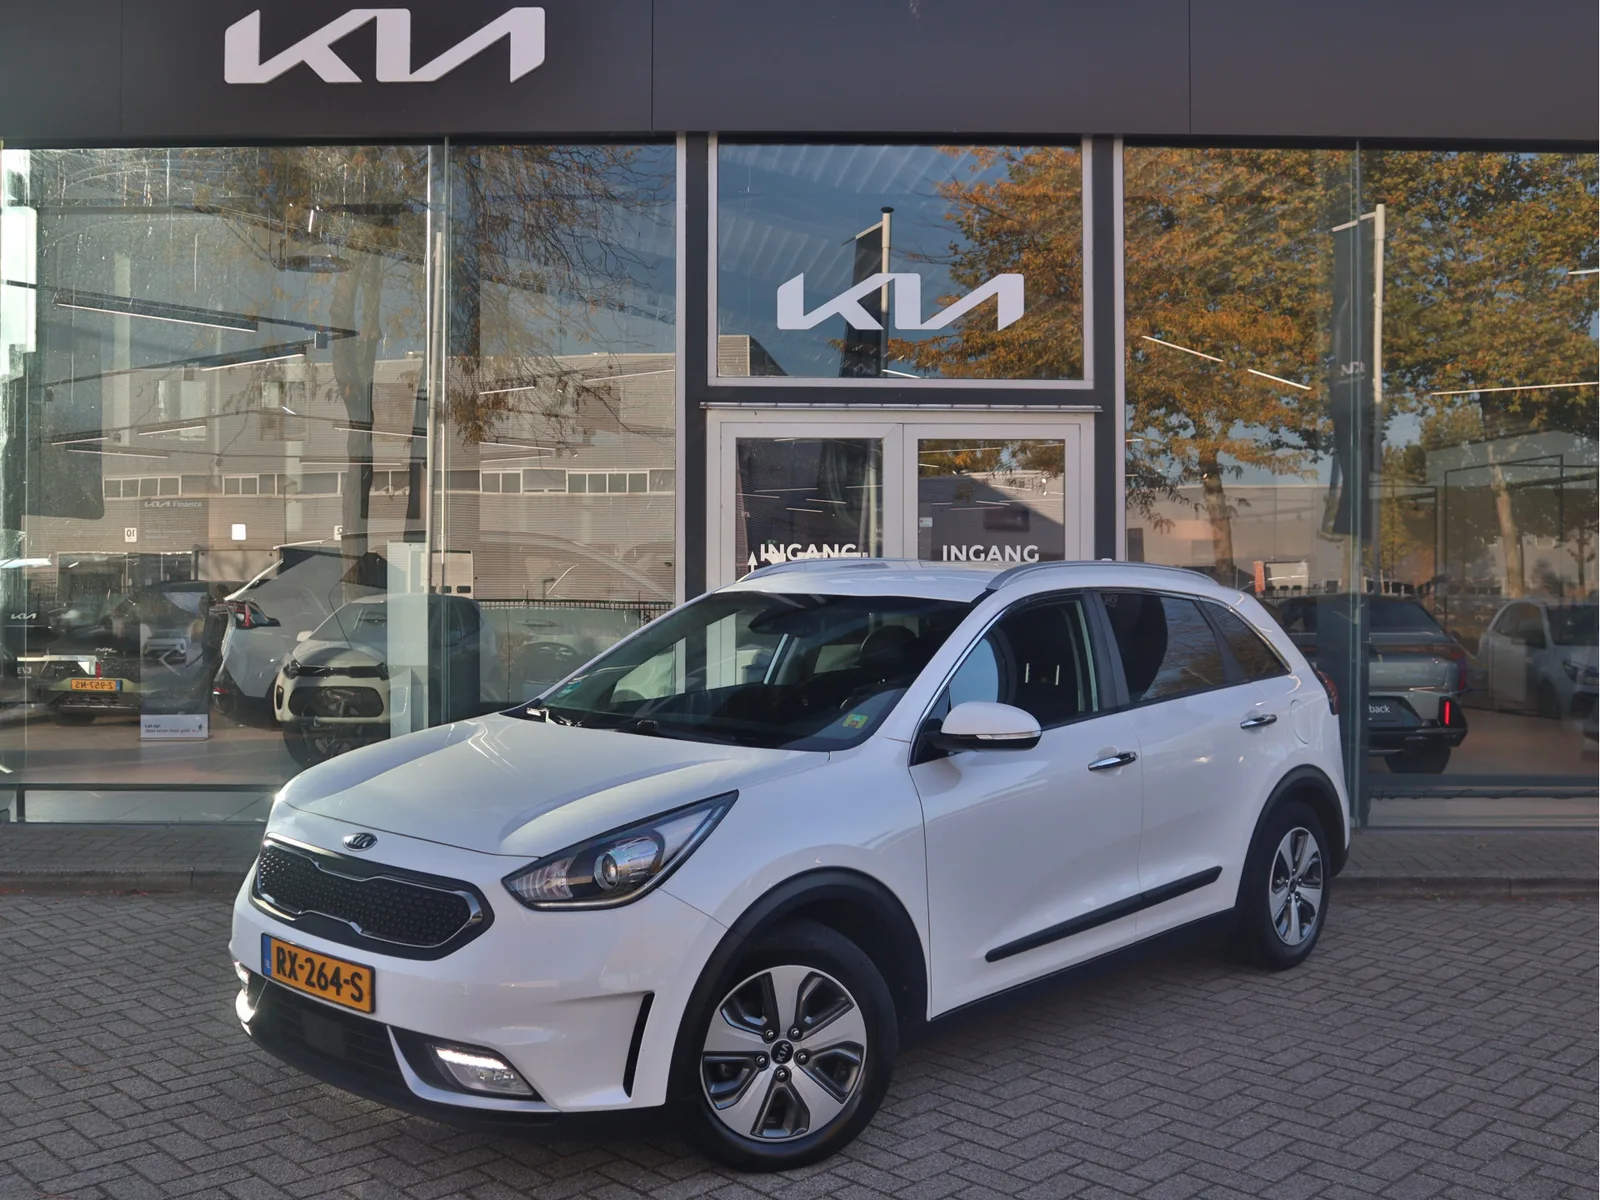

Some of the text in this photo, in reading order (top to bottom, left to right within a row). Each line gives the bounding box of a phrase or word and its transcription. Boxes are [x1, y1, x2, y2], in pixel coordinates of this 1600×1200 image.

[224, 6, 545, 84] KIA
[777, 272, 1024, 331] KIA
[942, 545, 1040, 563] INGANG
[276, 946, 363, 1002] RX-264-S
